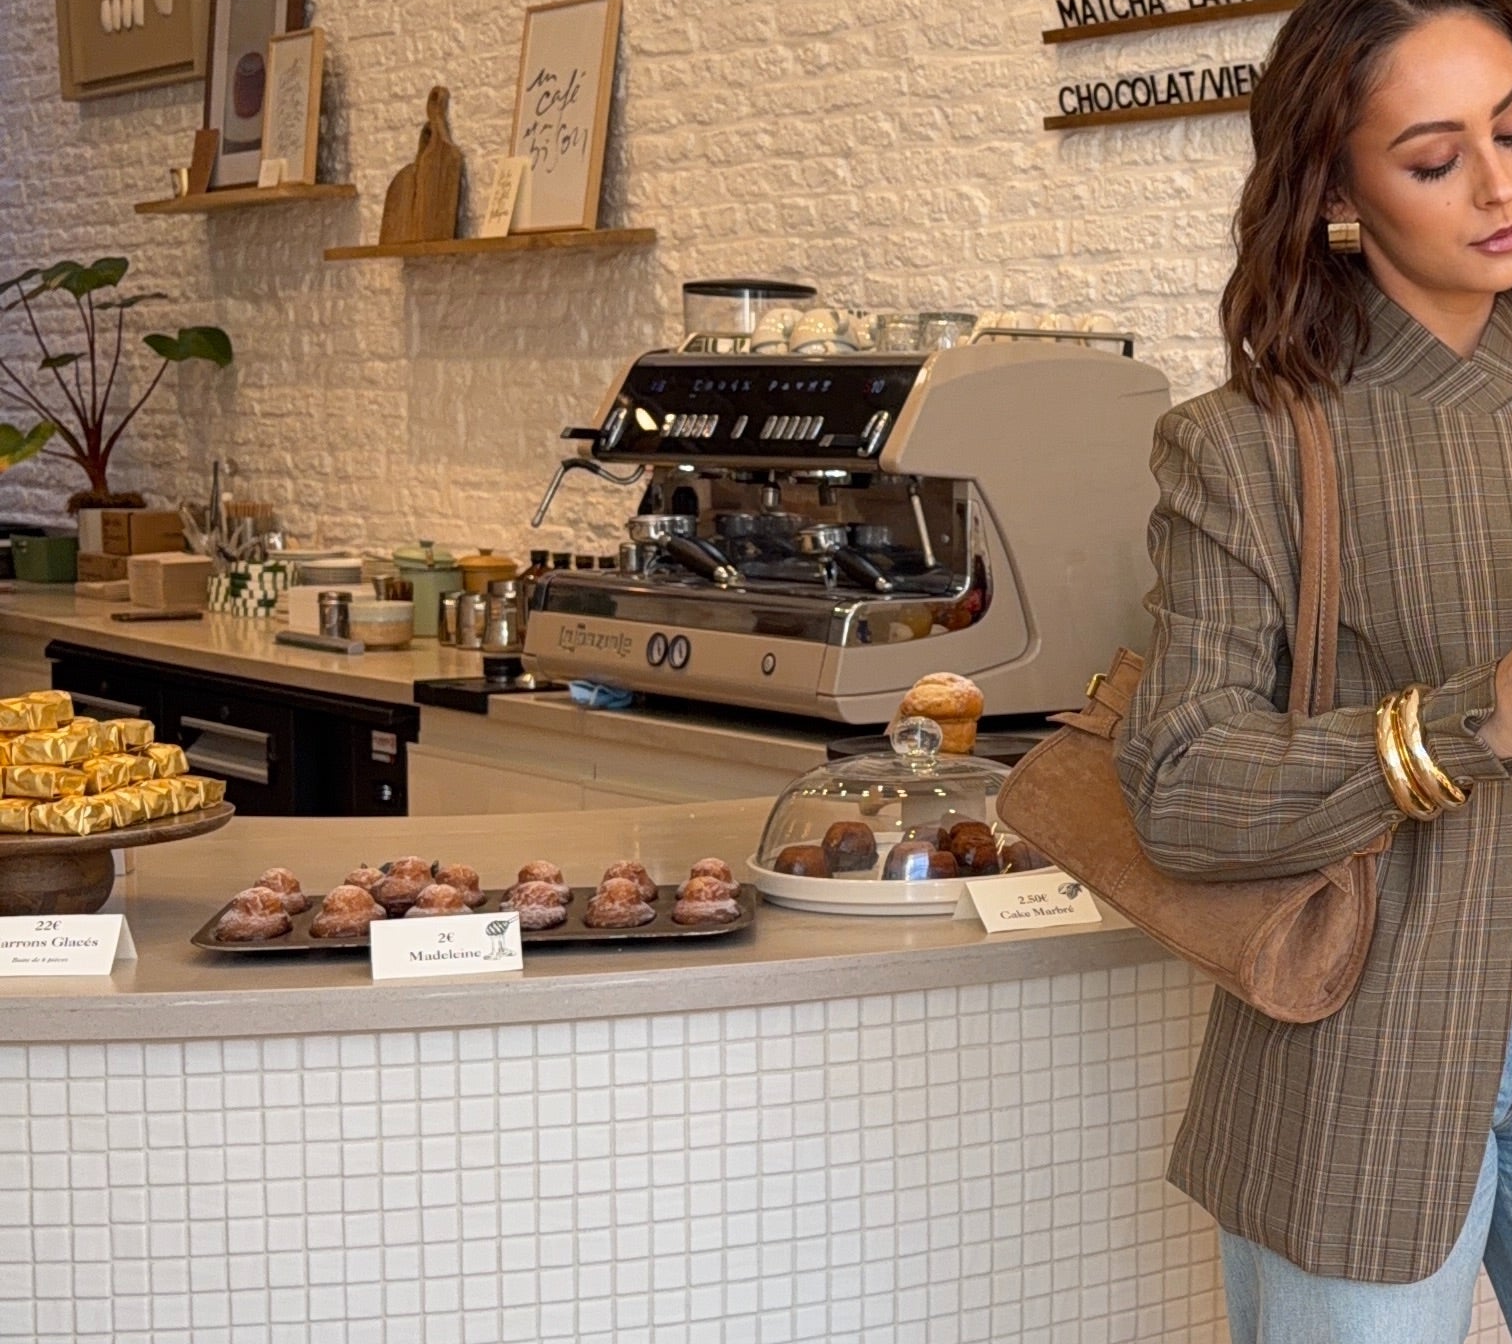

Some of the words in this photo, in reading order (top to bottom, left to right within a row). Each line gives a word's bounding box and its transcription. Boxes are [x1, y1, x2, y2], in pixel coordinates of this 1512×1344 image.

[1000, 909, 1031, 920] Cake
[1032, 903, 1076, 918] Marbré
[35, 919, 62, 931] 22€
[0, 939, 48, 949] arrons
[51, 935, 99, 948] Glacés
[437, 932, 455, 944] 2€
[408, 948, 482, 962] Madeleine
